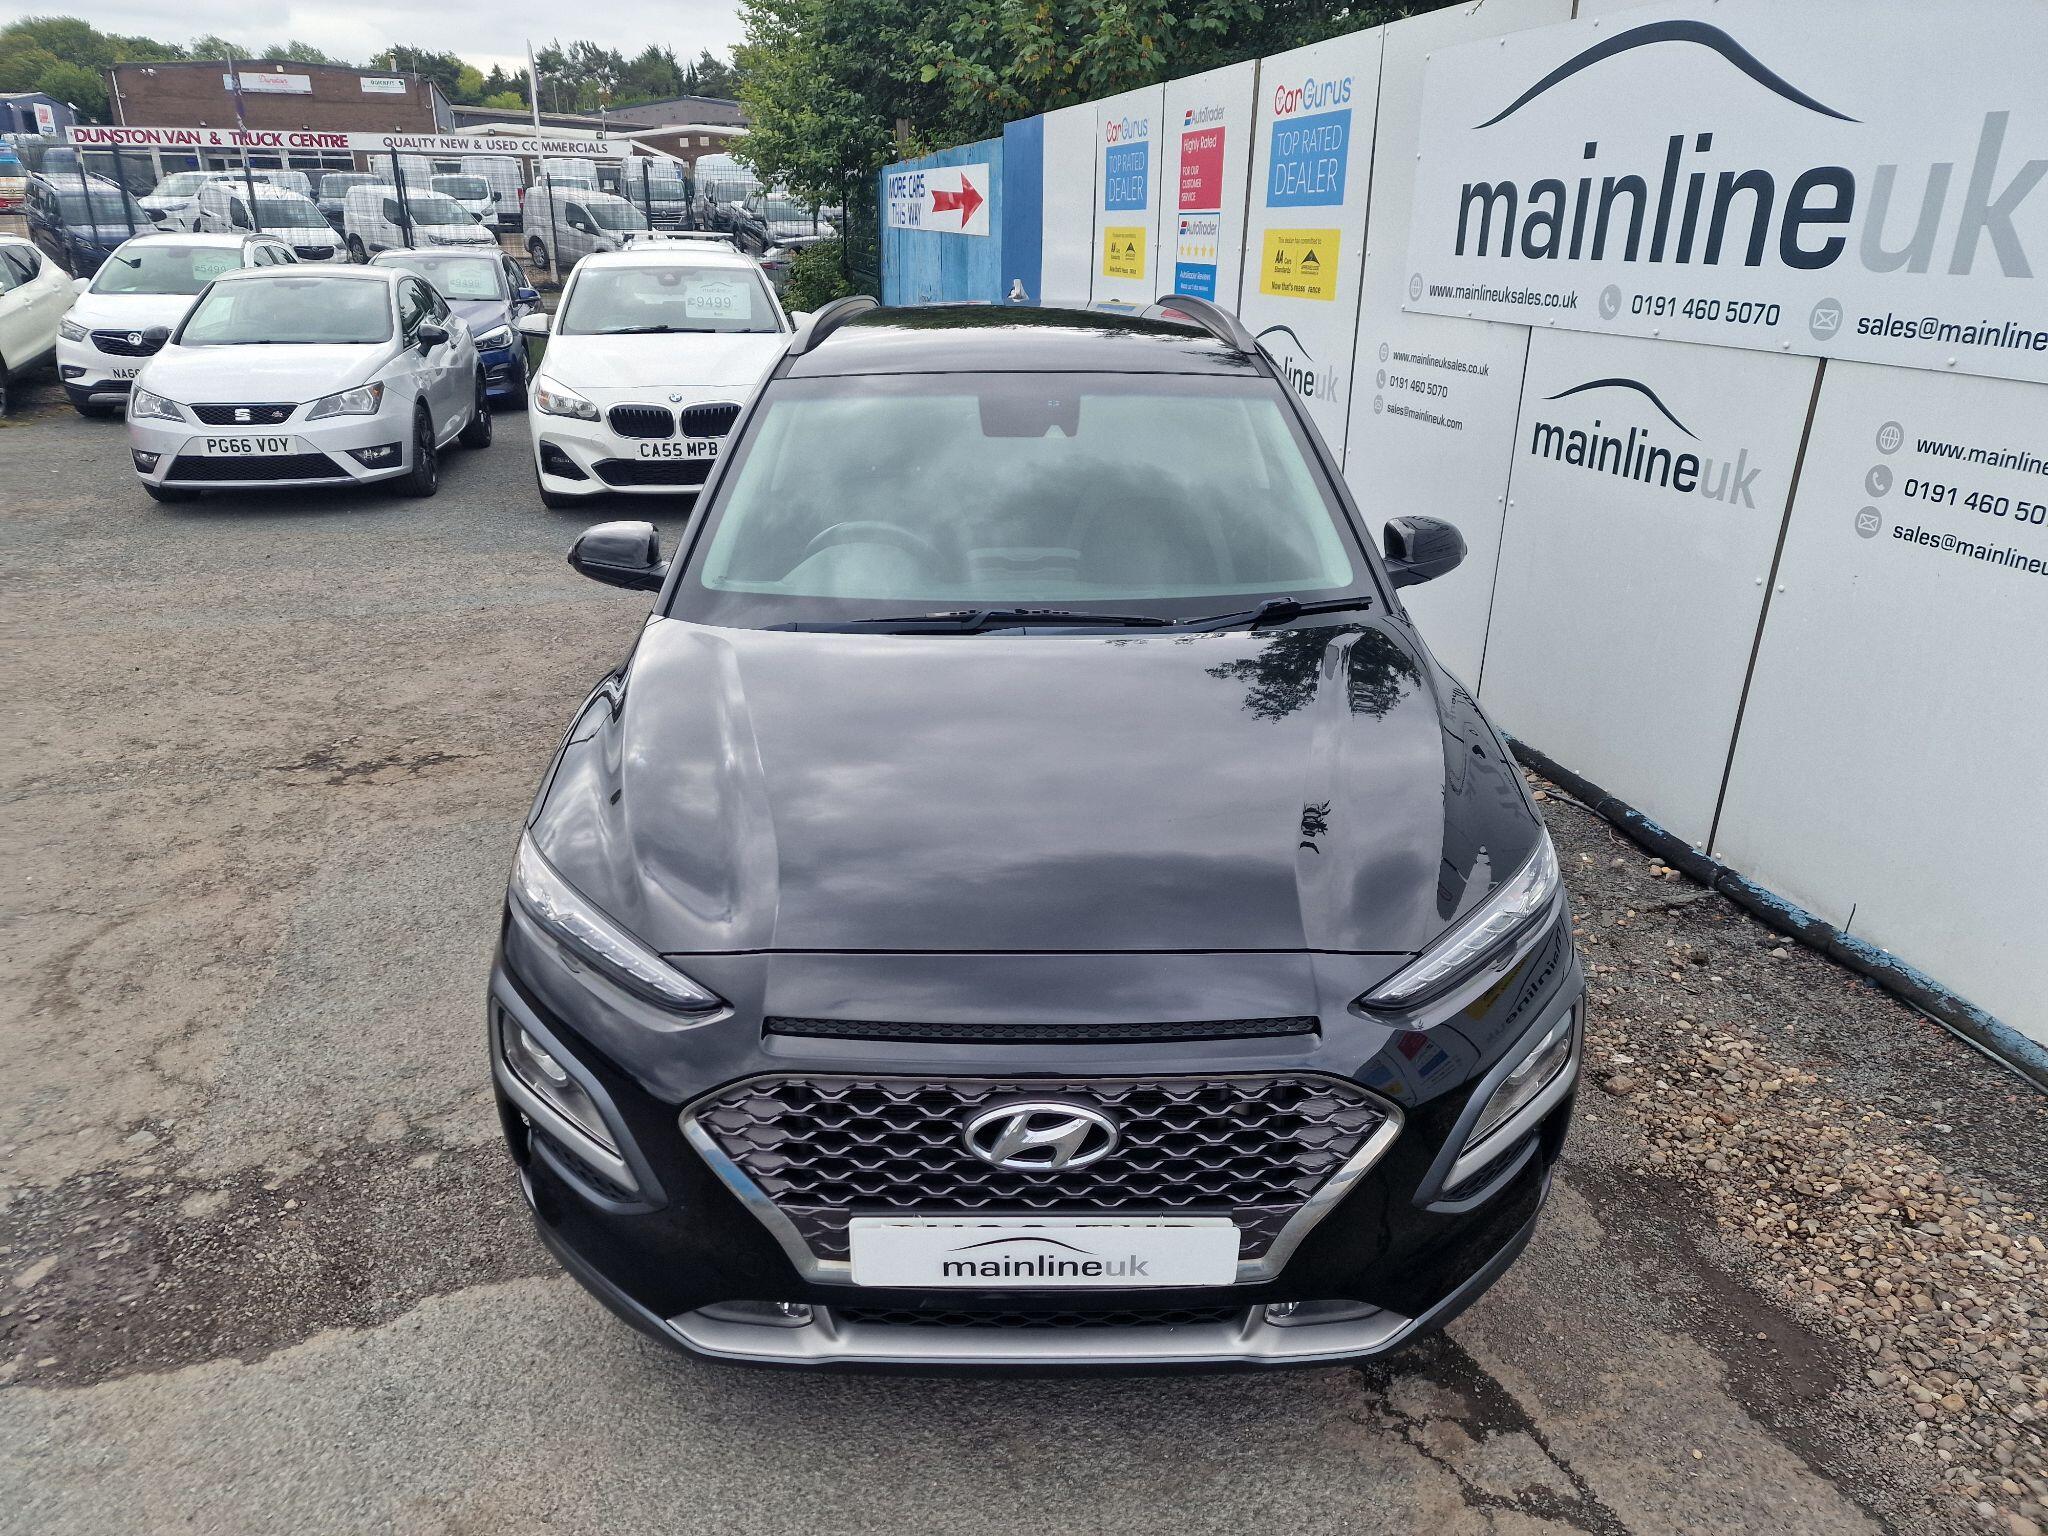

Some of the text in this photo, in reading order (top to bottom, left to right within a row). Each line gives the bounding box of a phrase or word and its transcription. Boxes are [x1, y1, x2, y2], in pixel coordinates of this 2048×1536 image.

[1275, 77, 1352, 115] CarGurus
[74, 128, 349, 148] DUNSTON VAN & TRUCK CENTRE
[1106, 117, 1148, 142] CarGurus
[1278, 125, 1343, 156] TOP RATED
[383, 137, 608, 153] QUALITY NEW & USED COMMERCIALS
[1109, 152, 1144, 173] TOP RATED
[889, 174, 926, 199] MORE CARS
[1109, 176, 1144, 201] DEALER
[1275, 158, 1338, 195] DEALER
[1455, 110, 2048, 278] mainlineuk
[892, 203, 922, 227] THIS WAY
[1186, 220, 1217, 236] AutoTrader
[1429, 283, 1578, 310] www.mainlineuksales.co.uk
[1631, 295, 1780, 326] 0191 460 5070
[1393, 350, 1489, 376] www.mainlineuksales.co.uk
[1284, 356, 1339, 403] lineuk
[1390, 375, 1448, 398] 0191 460 5070
[1387, 402, 1463, 431] sales@mainlineuk.com
[206, 437, 289, 453] PG66 VOY
[640, 441, 718, 458] CA55 MPB
[1531, 419, 1762, 510] mainlineuk
[1904, 478, 1957, 506] 0191
[1964, 491, 2009, 517] 460
[943, 1254, 1150, 1278] mainlineuk
